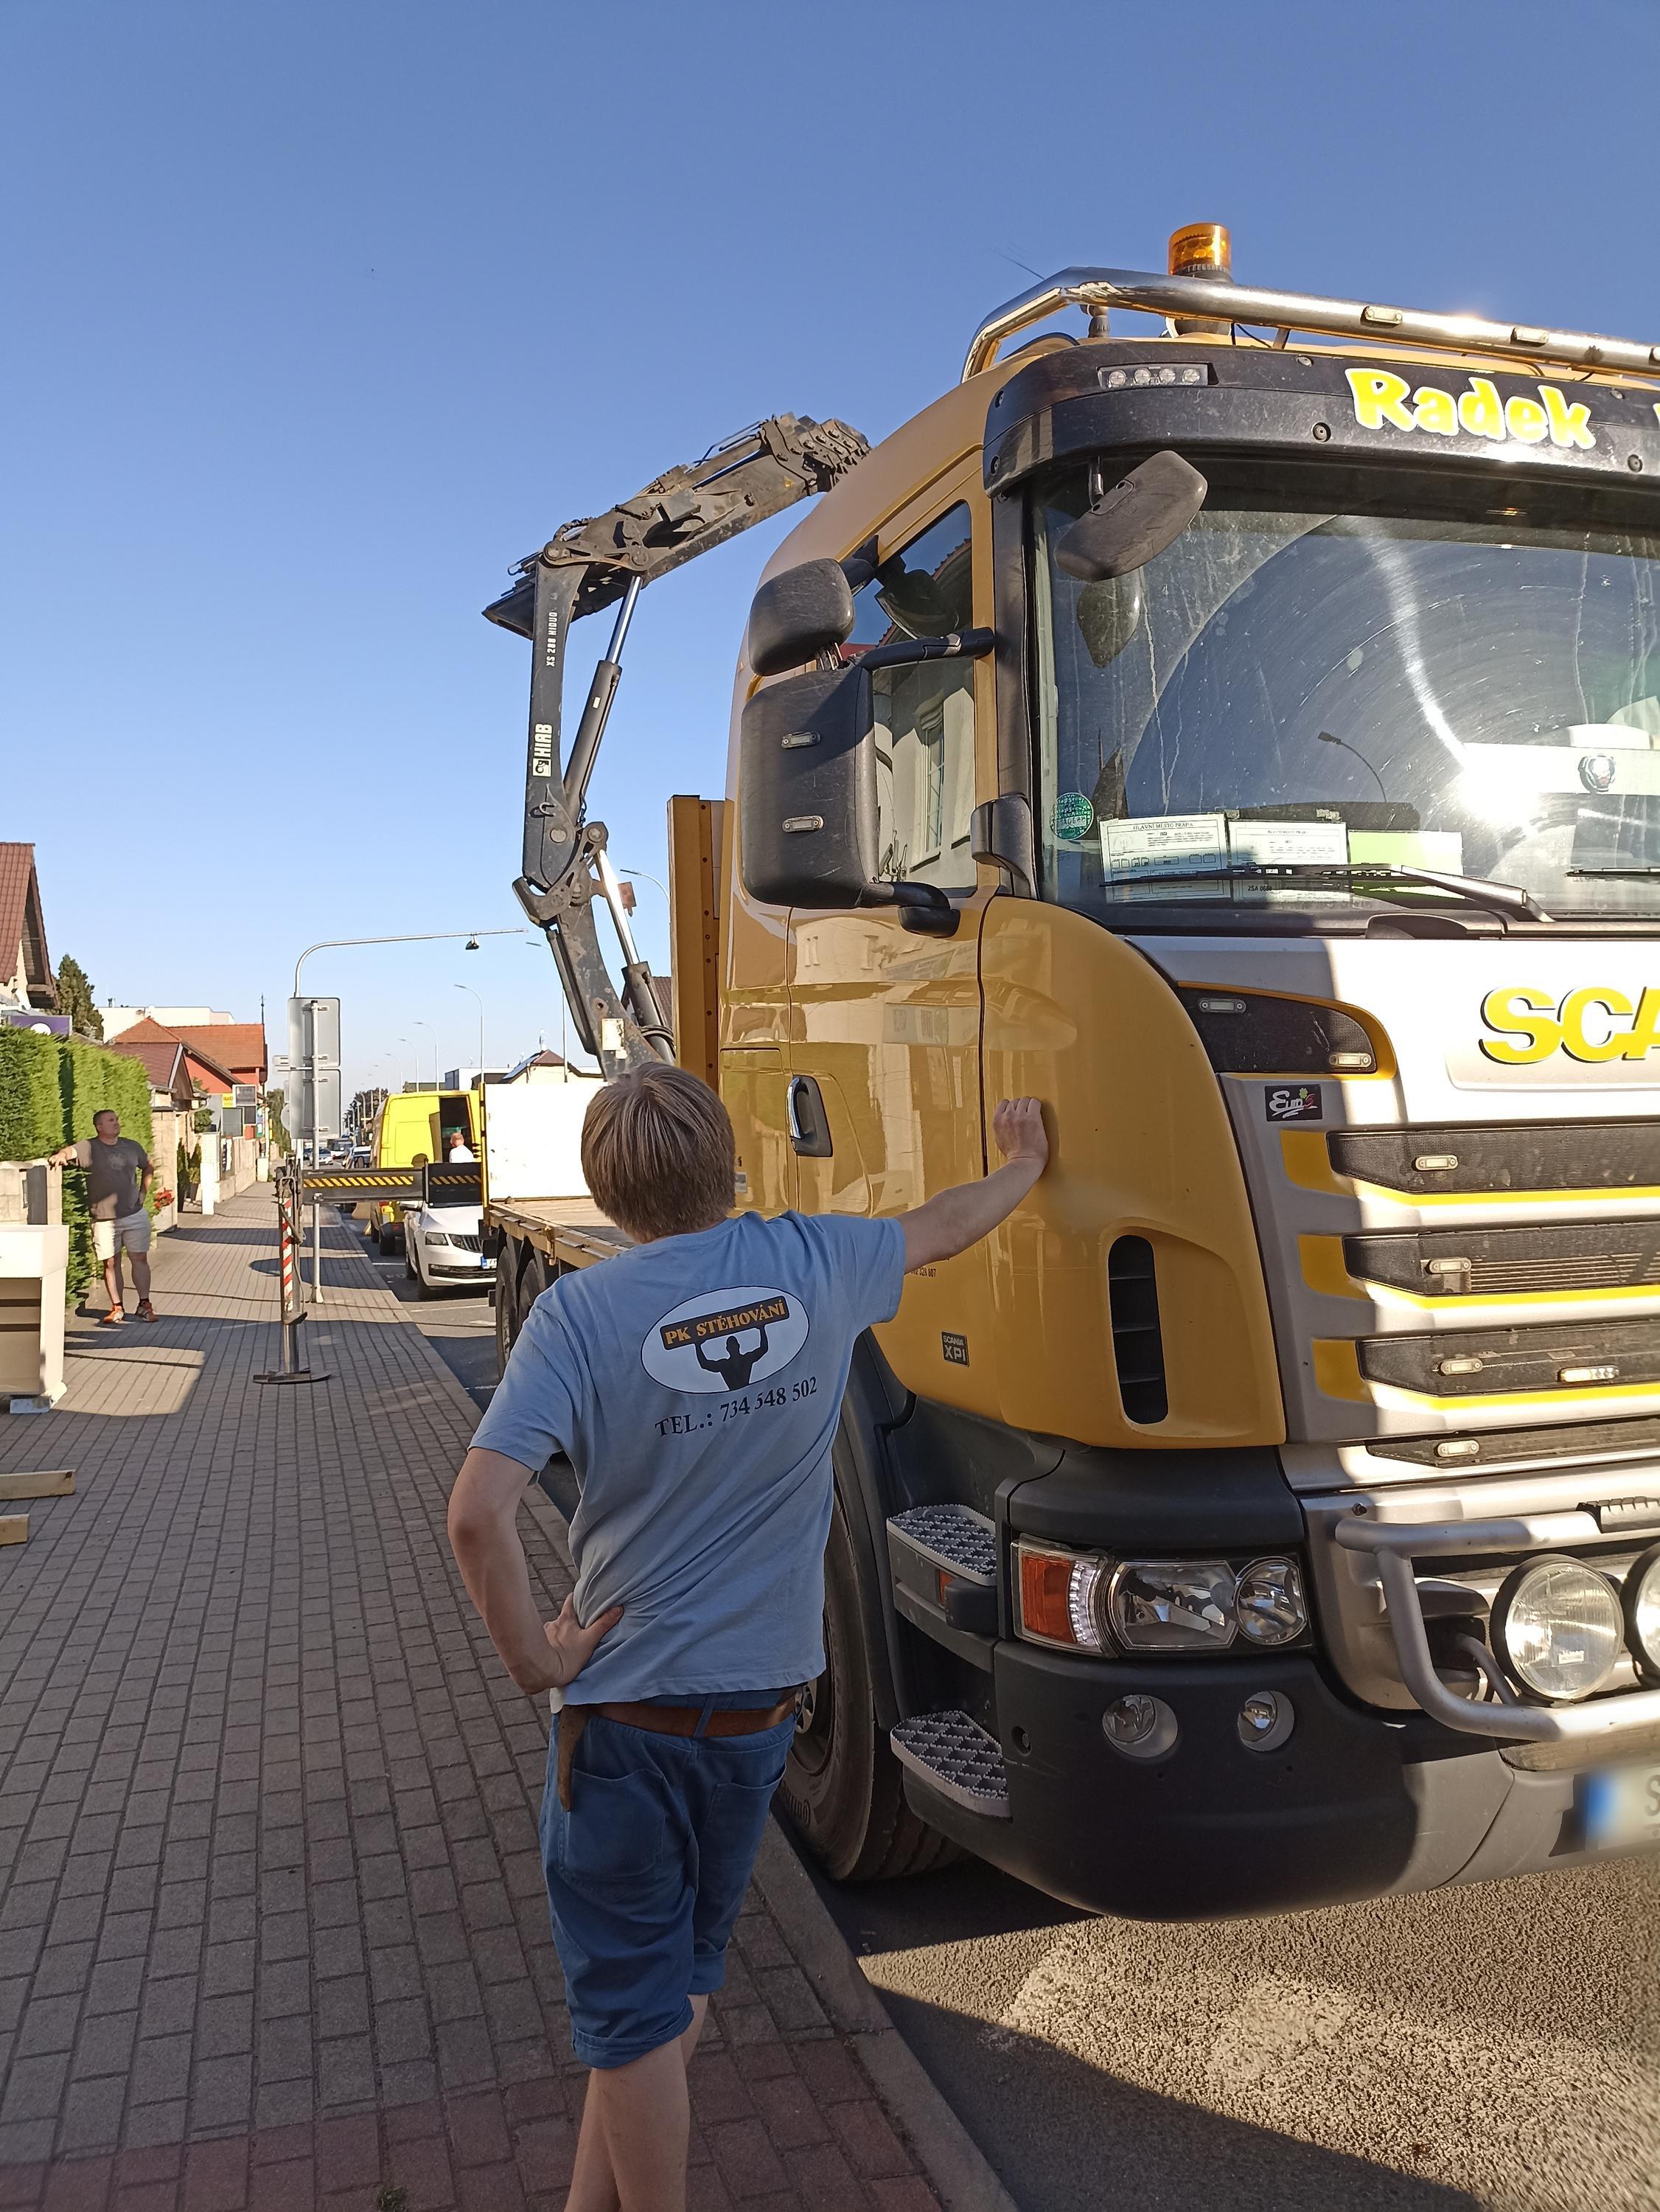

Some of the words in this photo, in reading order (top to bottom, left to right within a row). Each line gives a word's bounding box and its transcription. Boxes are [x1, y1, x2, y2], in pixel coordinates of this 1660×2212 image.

[1345, 368, 1597, 450] Radek
[548, 612, 558, 636] HIDUO
[546, 656, 555, 667] XS
[534, 723, 552, 757] HIAB
[665, 1326, 691, 1345] PK
[696, 1299, 787, 1337] STĚHOVÁNÍ
[944, 1344, 966, 1362] XPI
[655, 1413, 713, 1437] TEL.:
[720, 1396, 750, 1422] 734
[754, 1387, 787, 1410] 548
[792, 1376, 817, 1402] 502
